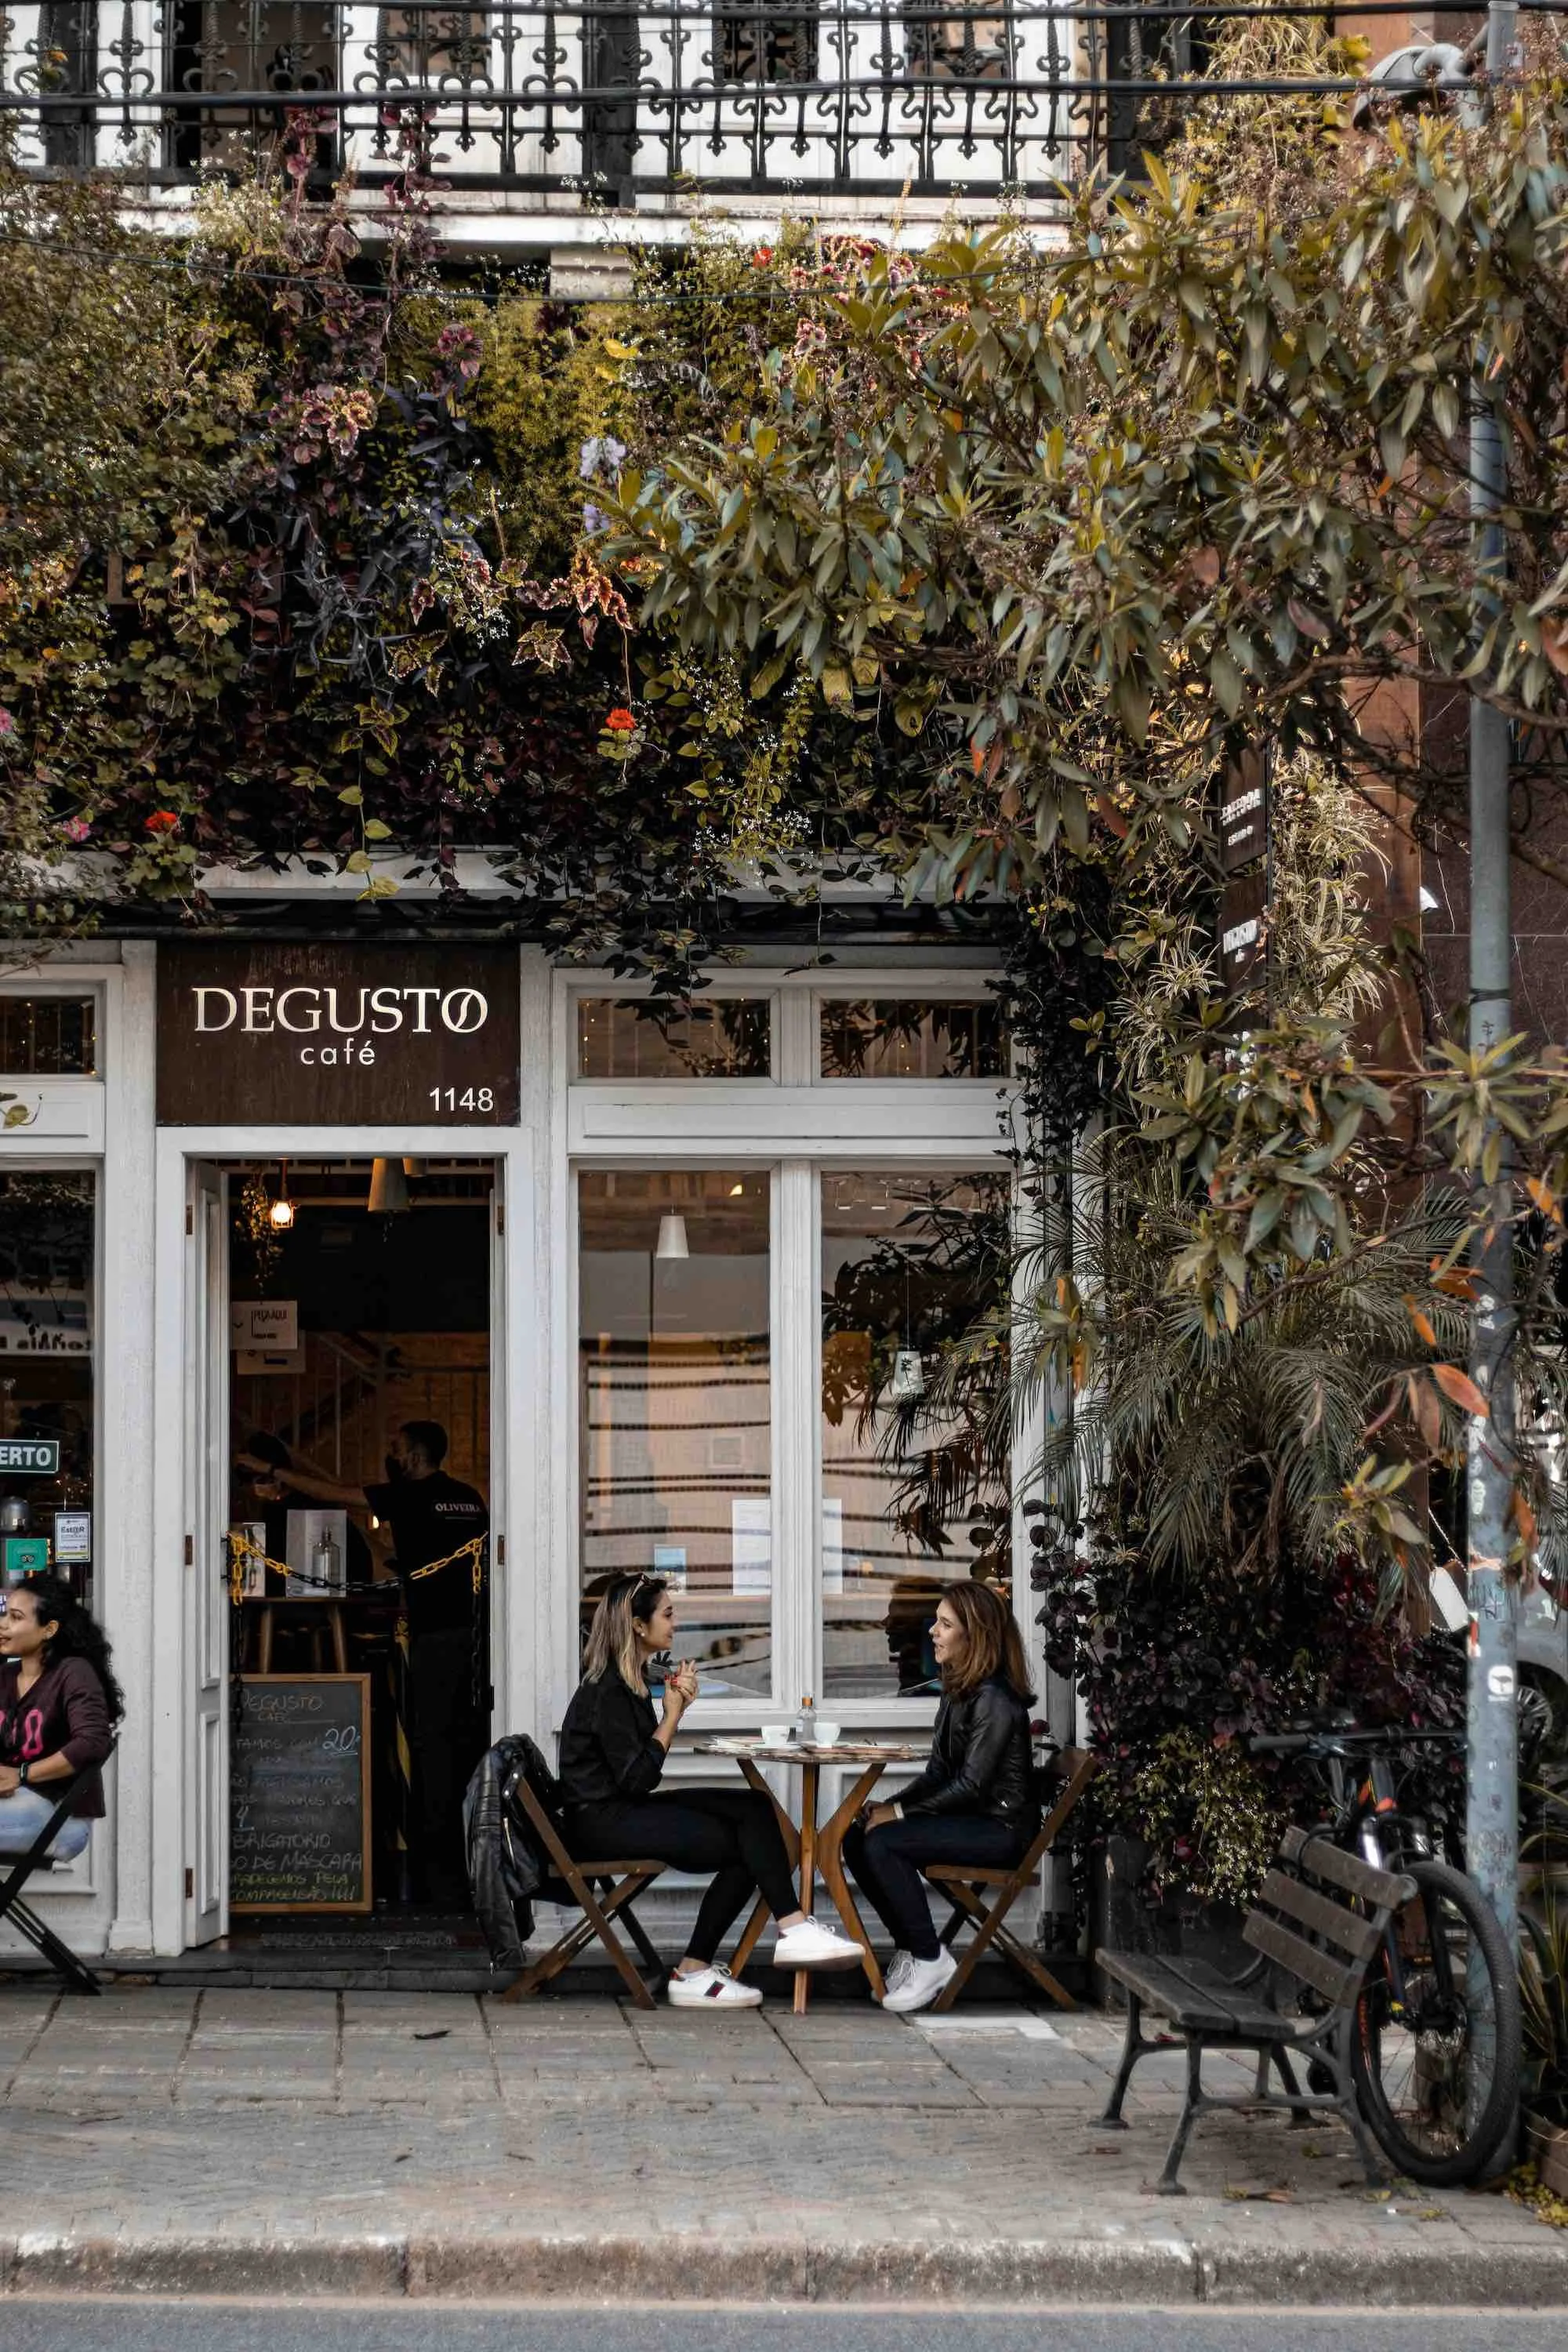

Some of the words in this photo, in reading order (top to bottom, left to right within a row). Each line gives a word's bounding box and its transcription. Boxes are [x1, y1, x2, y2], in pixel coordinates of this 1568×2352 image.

[191, 986, 489, 1034] DEGUSTO
[299, 1036, 376, 1066] café
[429, 1087, 495, 1112] 1148
[252, 1854, 276, 1871] DE
